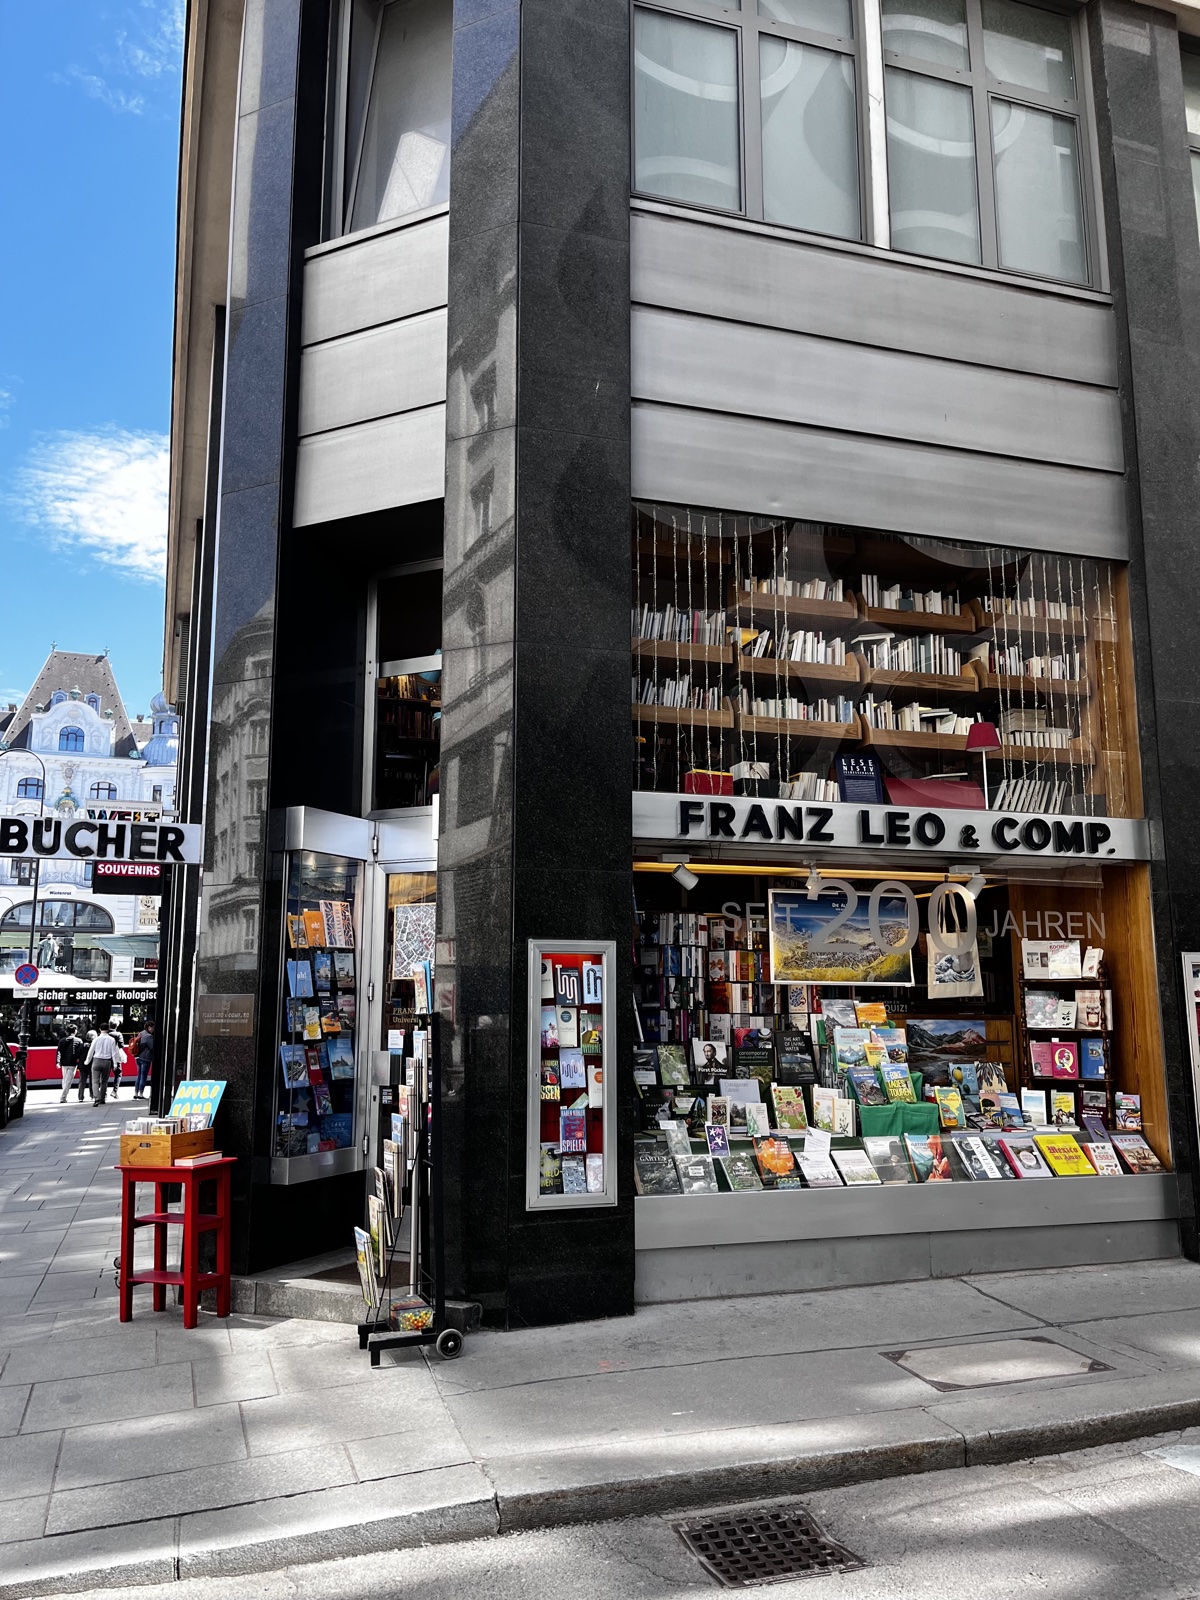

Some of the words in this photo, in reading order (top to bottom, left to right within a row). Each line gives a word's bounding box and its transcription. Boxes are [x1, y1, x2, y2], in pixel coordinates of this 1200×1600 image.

[0, 817, 185, 862] BÜCHER
[679, 800, 834, 842] FRANZ
[859, 809, 946, 847] LEO
[961, 824, 980, 848] &
[991, 816, 1116, 854] COMP.
[97, 864, 160, 876] SOUVENIRS
[806, 878, 978, 955] 200
[984, 908, 1106, 940] JAHREN
[38, 990, 68, 1000] sicher
[75, 990, 108, 1000] sauber
[562, 1139, 587, 1152] SPIELEN
